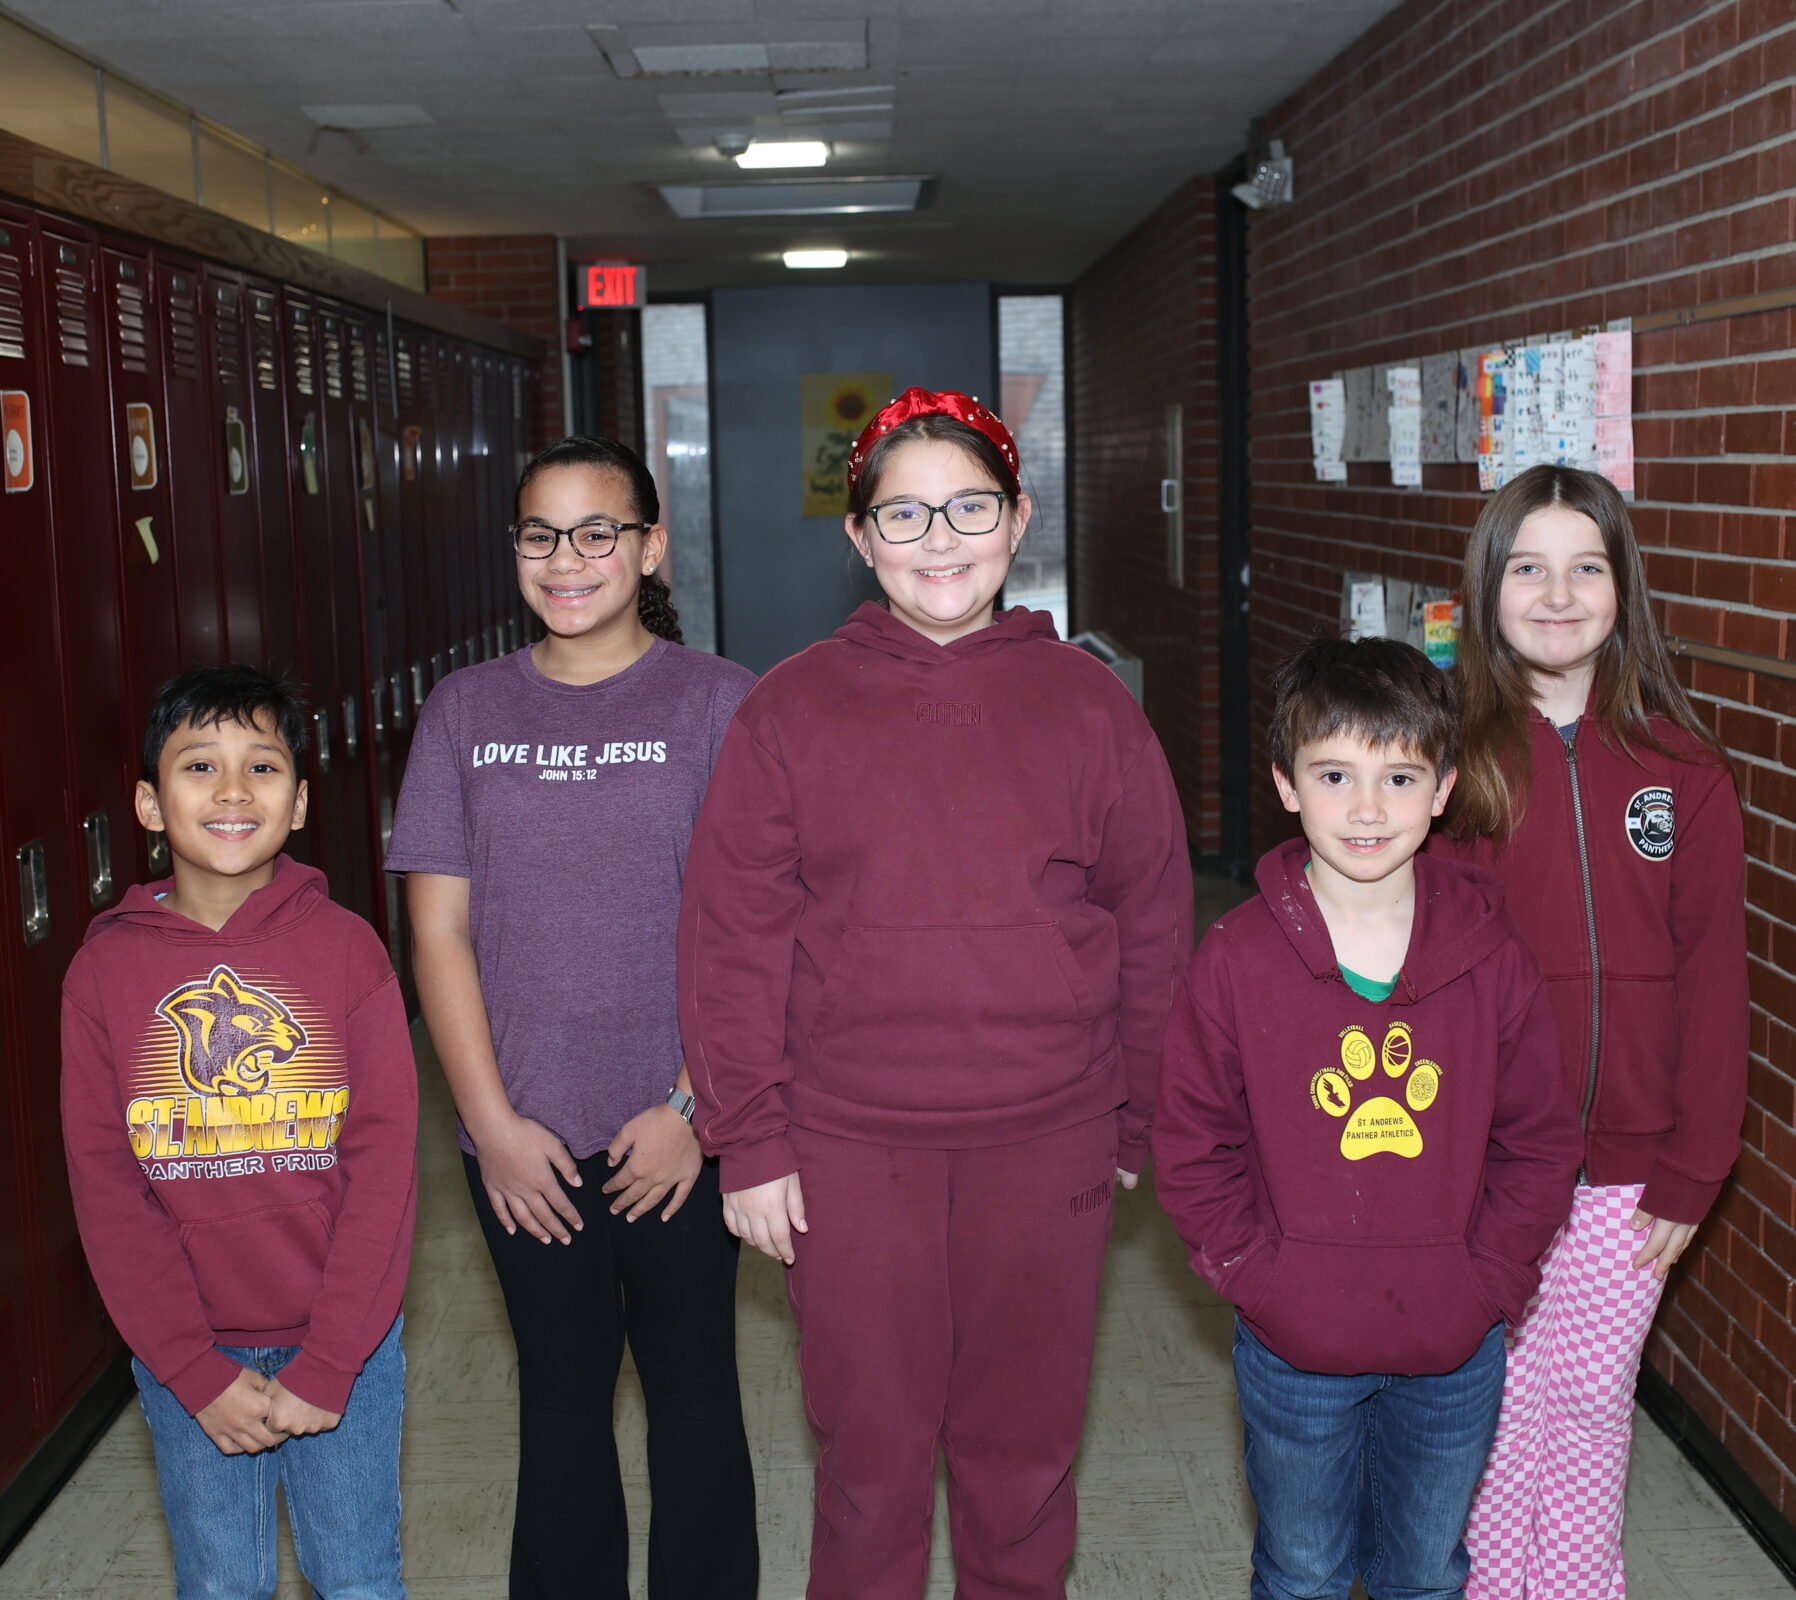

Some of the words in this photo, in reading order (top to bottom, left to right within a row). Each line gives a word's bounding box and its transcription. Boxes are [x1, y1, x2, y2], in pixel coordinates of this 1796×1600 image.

[588, 266, 637, 305] EXIT
[473, 742, 530, 768] LOVE
[536, 744, 588, 766] LIKE
[595, 741, 667, 764] JESUS
[538, 769, 568, 780] JOHN
[571, 769, 597, 780] 15:12
[1633, 799, 1644, 810] ST.
[1346, 1130, 1379, 1140] PANTHER
[1380, 1129, 1414, 1139] ATHLETICS
[272, 1153, 338, 1172] PRID
